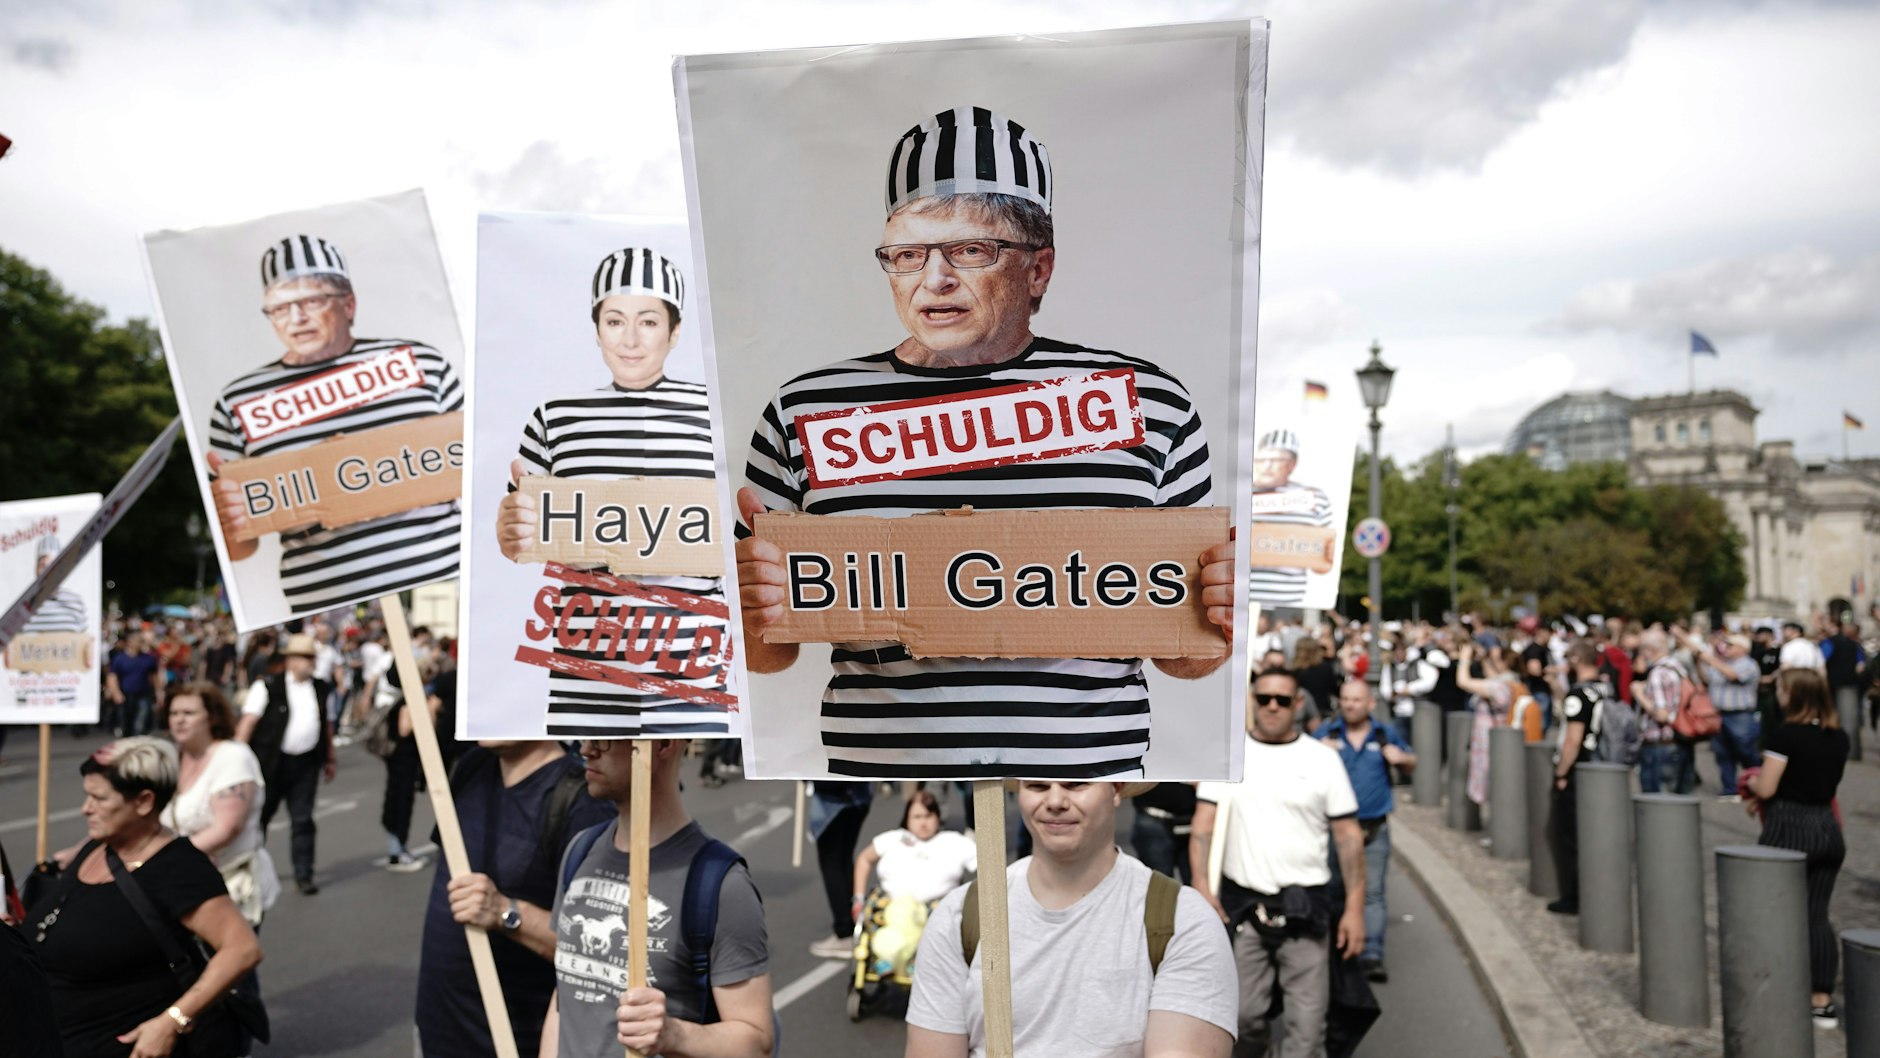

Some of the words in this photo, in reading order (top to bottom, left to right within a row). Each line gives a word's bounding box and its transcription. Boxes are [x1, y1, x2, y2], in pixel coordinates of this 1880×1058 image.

[251, 359, 410, 429] SCHULDIG
[821, 389, 1119, 469] SCHULDIG
[242, 469, 319, 518] Bill
[335, 440, 464, 493] Gates
[540, 490, 713, 558] Haya
[786, 551, 909, 611] Bill
[944, 549, 1189, 611] Gates
[20, 641, 77, 661] Merkel
[558, 953, 627, 985] JEANS
